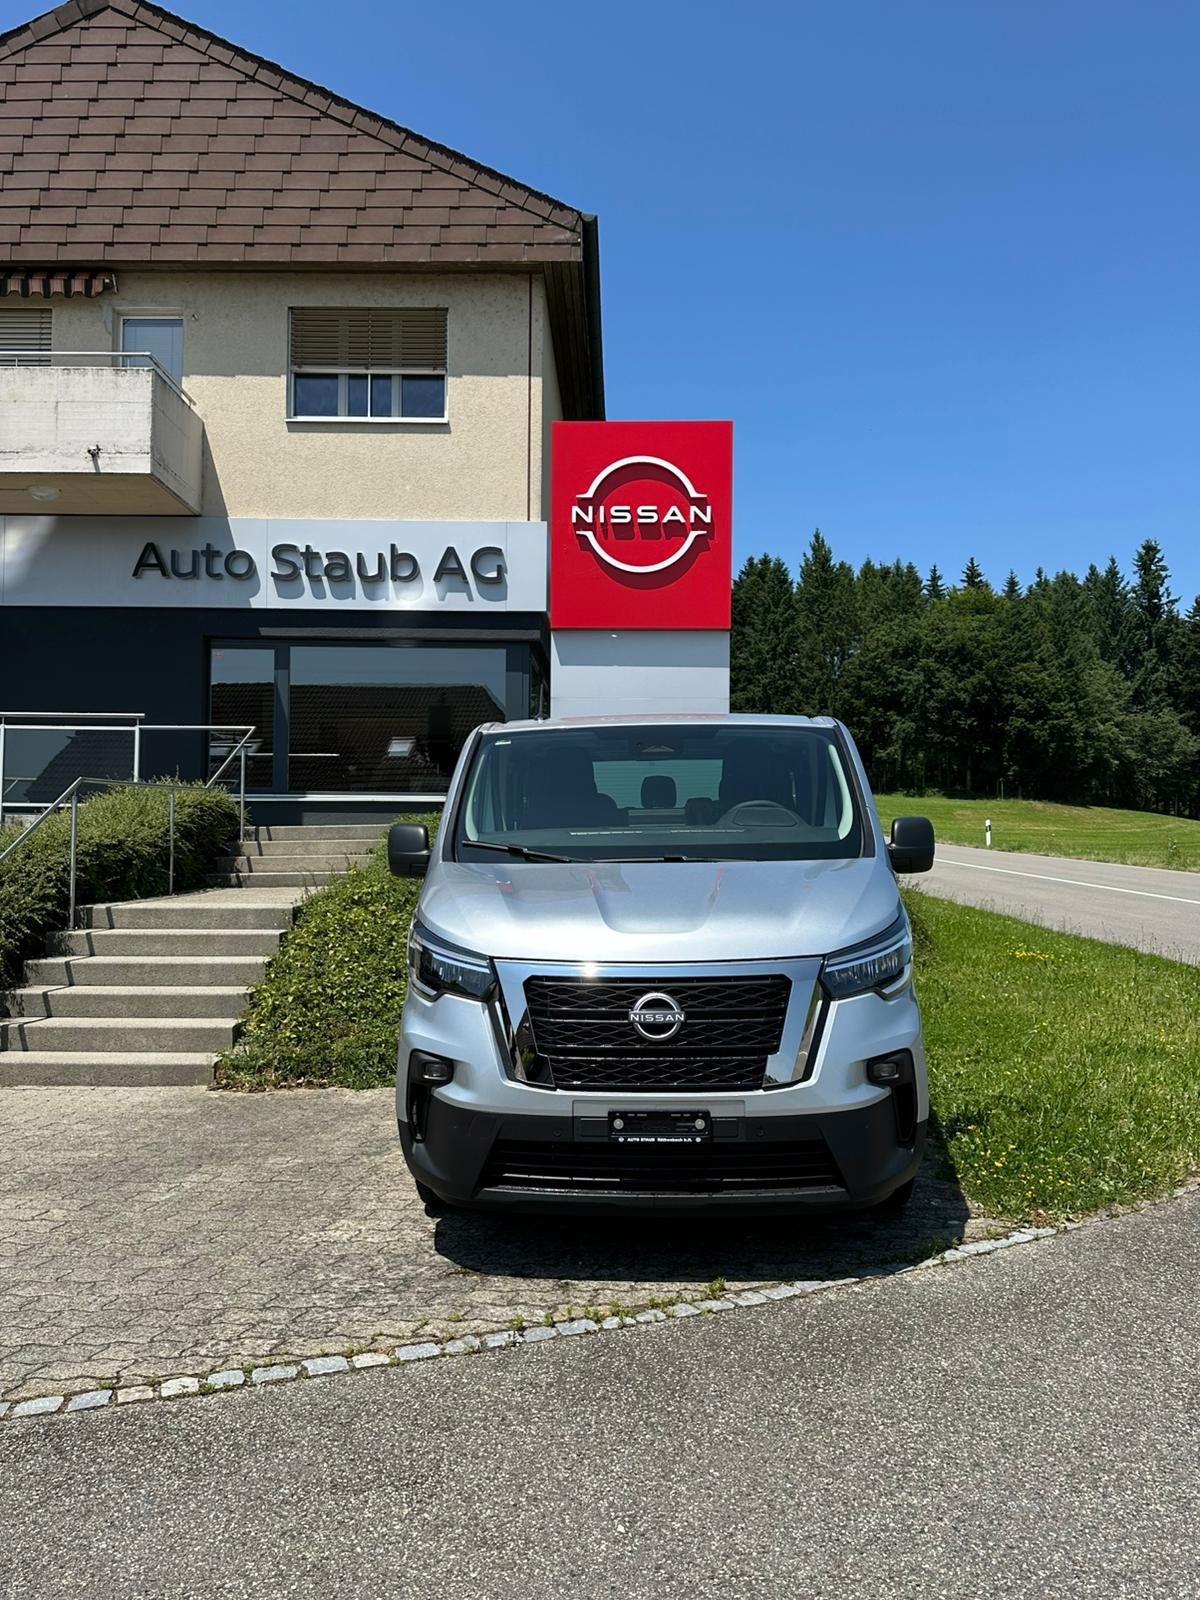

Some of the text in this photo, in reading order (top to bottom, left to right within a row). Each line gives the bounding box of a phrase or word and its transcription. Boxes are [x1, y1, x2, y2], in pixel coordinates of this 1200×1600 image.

[571, 505, 712, 524] NISSAN
[132, 541, 505, 585] Auto Staub AG
[630, 1013, 685, 1022] NISSAN
